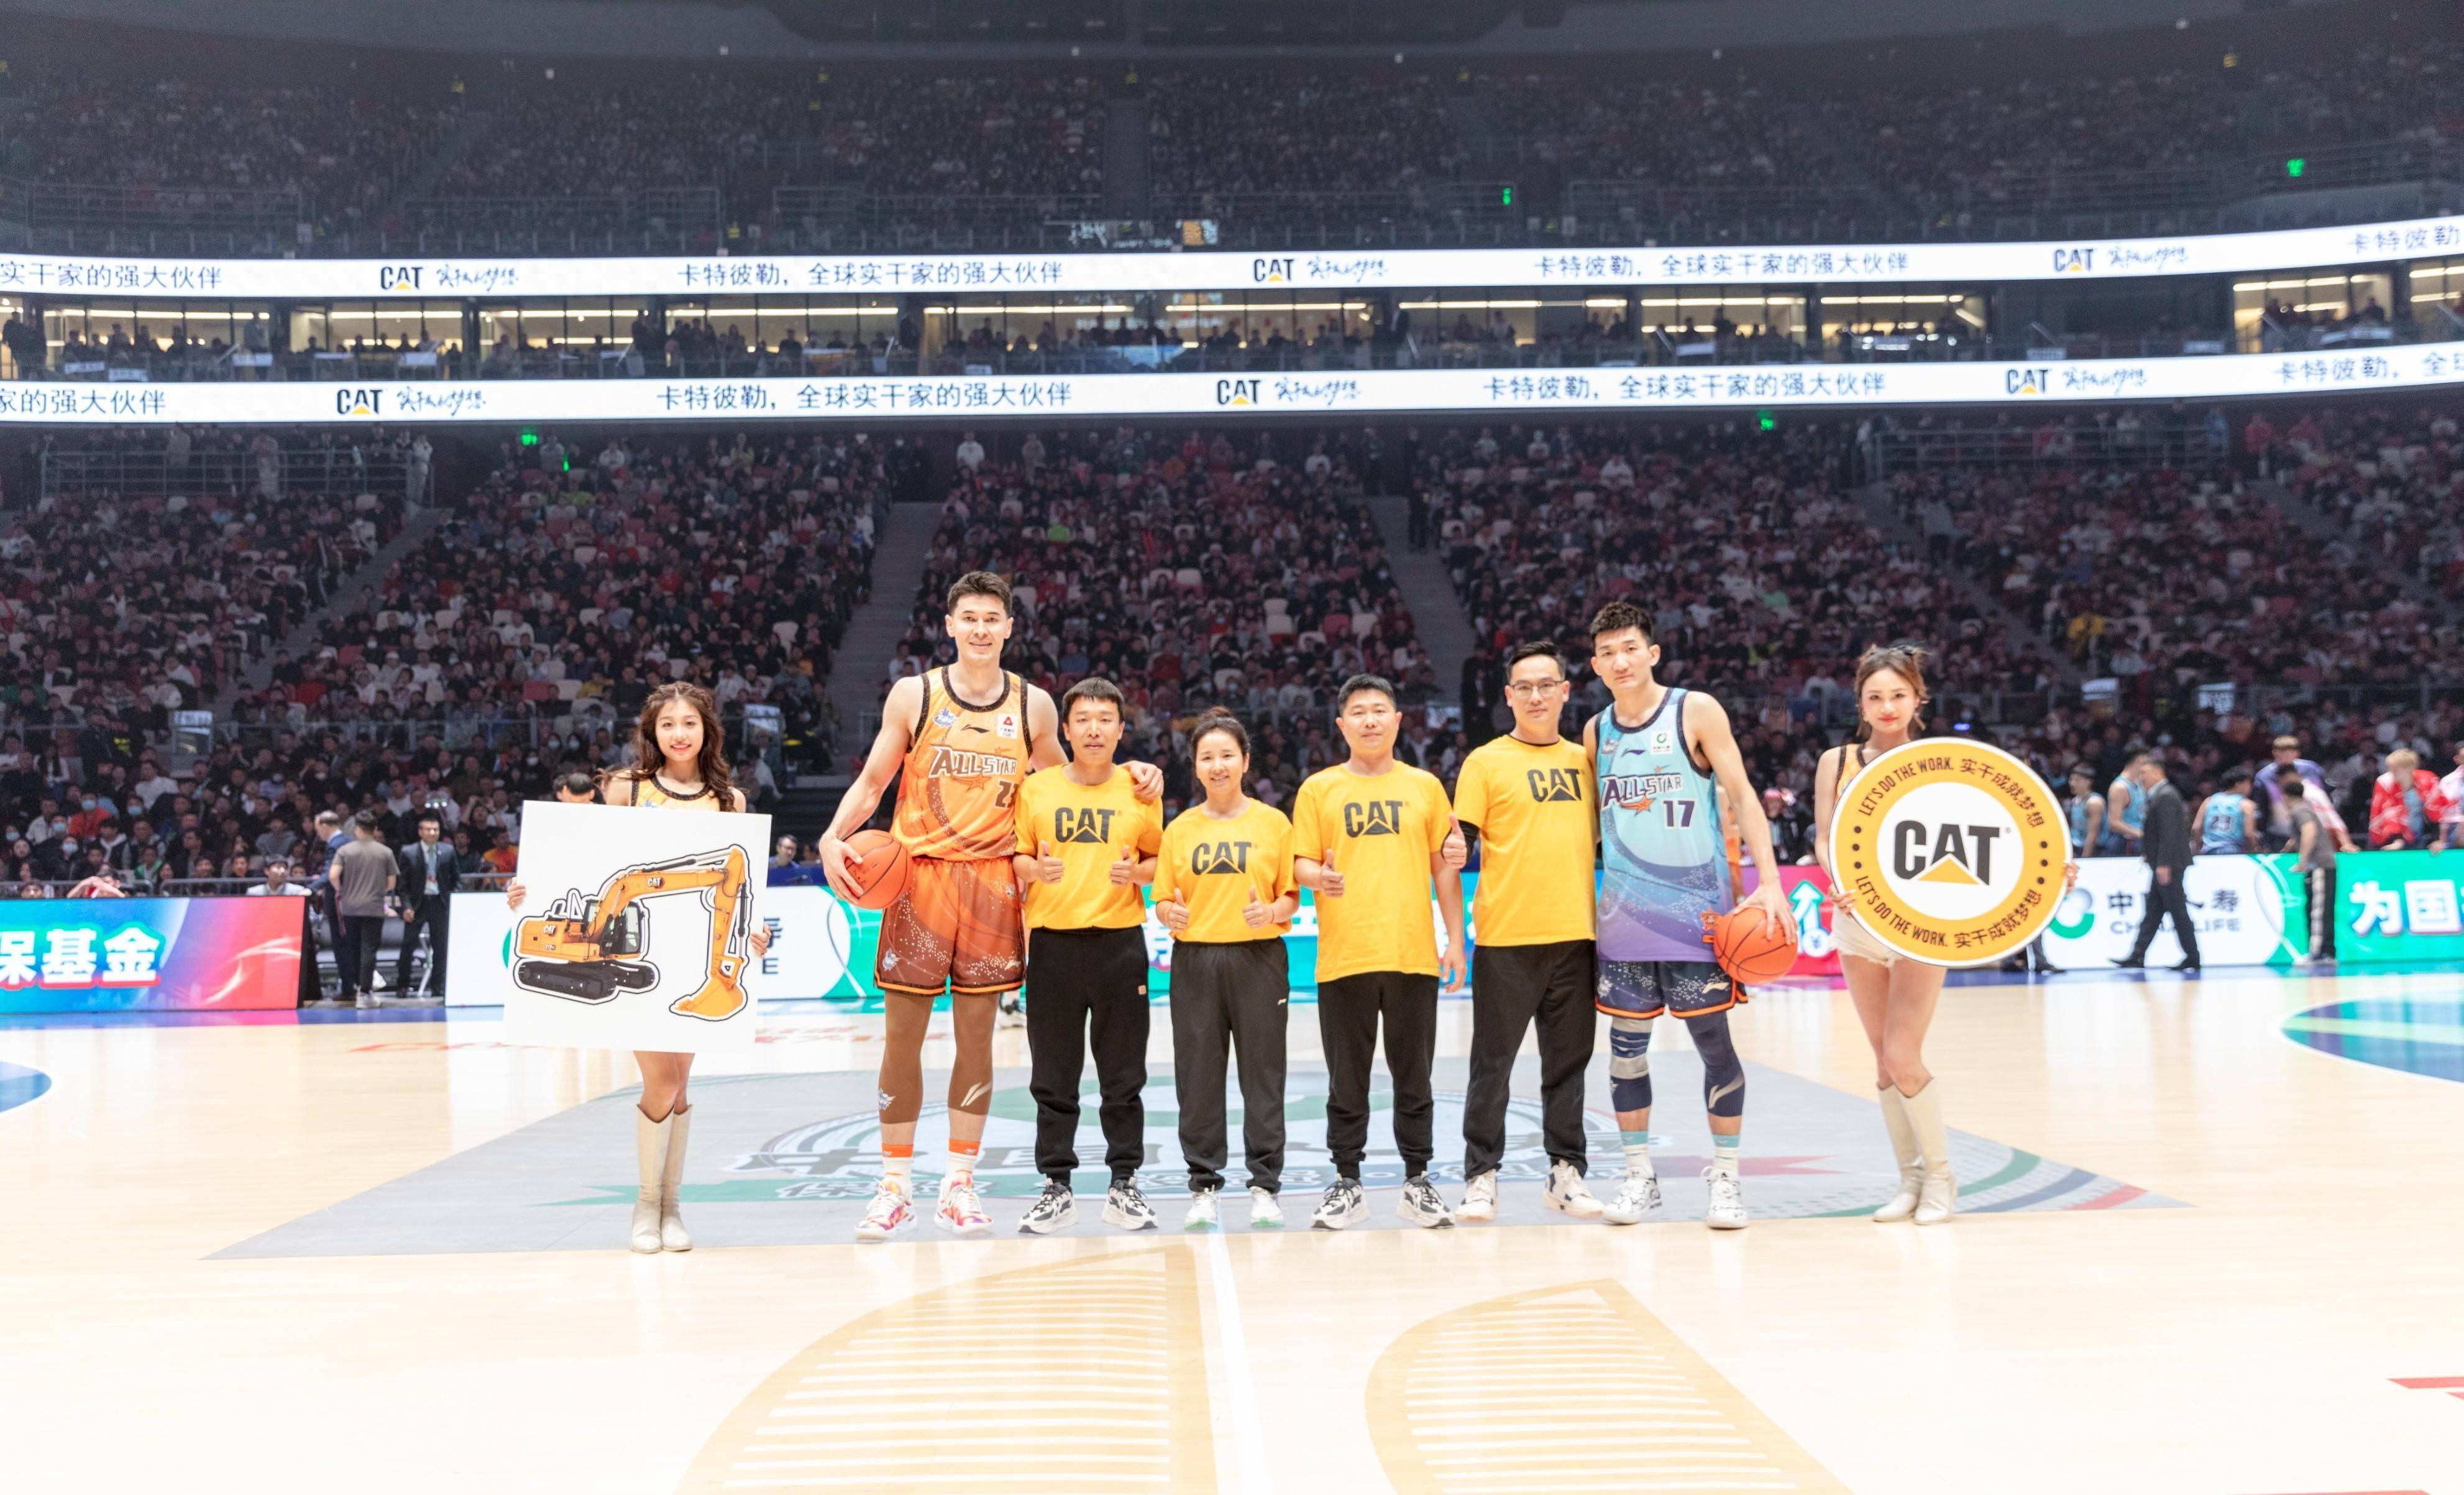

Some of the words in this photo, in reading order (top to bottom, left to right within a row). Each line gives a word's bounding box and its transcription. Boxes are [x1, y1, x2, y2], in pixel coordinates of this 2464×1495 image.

[1253, 258, 1295, 282] CAT
[2054, 248, 2094, 272] CAT
[0, 261, 221, 288] 实干家的强大伙伴
[380, 266, 424, 290] CAT
[1217, 379, 1262, 405] CAT
[2007, 369, 2050, 394] CAT
[0, 389, 165, 415] 家的强大伙伴
[337, 389, 383, 415] CAT
[1527, 768, 1581, 802] CAT
[1858, 788, 1884, 816] LET'S
[1878, 775, 1896, 792] DO
[1892, 763, 1917, 781] THE
[1917, 757, 1954, 773] WORK.
[1960, 758, 2045, 828] 实干成就梦想
[1055, 807, 1115, 844] CAT
[1344, 801, 1403, 837] CAT
[1662, 799, 1695, 828] 17
[1192, 841, 1251, 875] CAT
[1893, 820, 2001, 886] CAT
[648, 877, 662, 888] CAT
[1856, 876, 1880, 905] LET'S
[1874, 902, 1892, 919] DO
[1889, 913, 1912, 935] THE
[1912, 925, 1948, 947] WORK.
[1954, 889, 2041, 949] 实干成就梦想
[2349, 879, 2464, 936] 为国
[543, 924, 557, 934] CAT
[0, 927, 160, 985] 保基金
